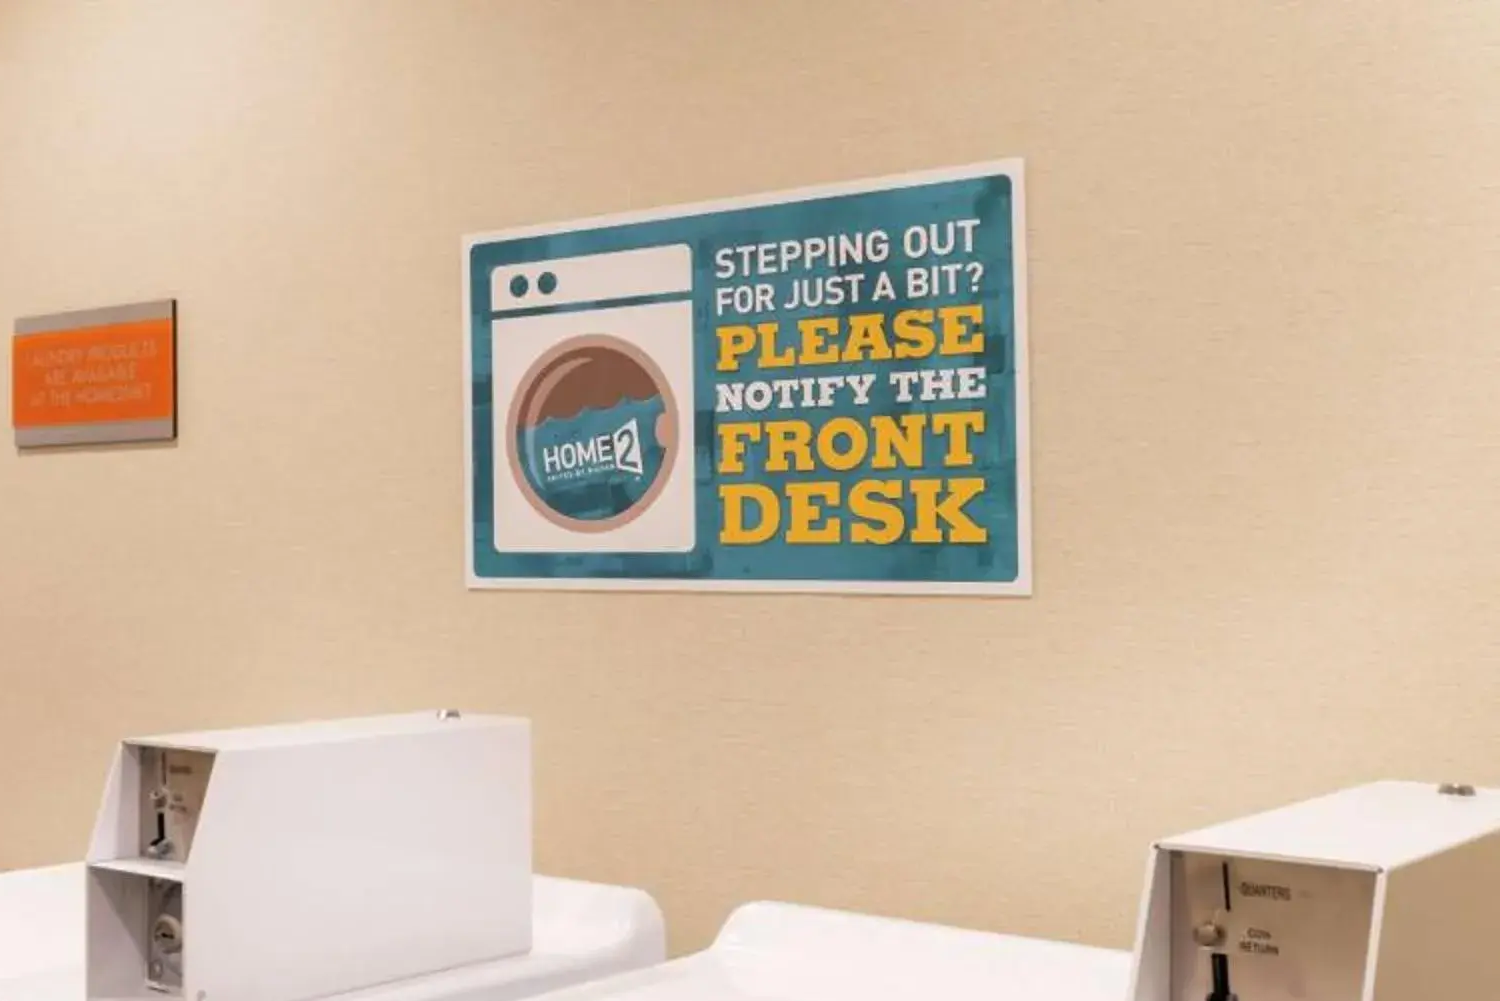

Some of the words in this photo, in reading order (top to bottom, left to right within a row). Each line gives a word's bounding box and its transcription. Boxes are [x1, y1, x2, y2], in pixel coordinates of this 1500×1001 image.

[714, 230, 889, 279] STEPPING
[903, 219, 980, 258] OUT
[716, 284, 775, 316] FOR
[784, 273, 864, 309] JUST
[872, 271, 896, 301] A
[907, 262, 984, 298] BIT?
[715, 304, 985, 371] PLEASE
[715, 373, 876, 413] NOTIFY
[889, 367, 987, 402] THE
[717, 411, 985, 473] FRONT
[718, 478, 987, 545] DESK
[1239, 941, 1280, 957] RETURN
